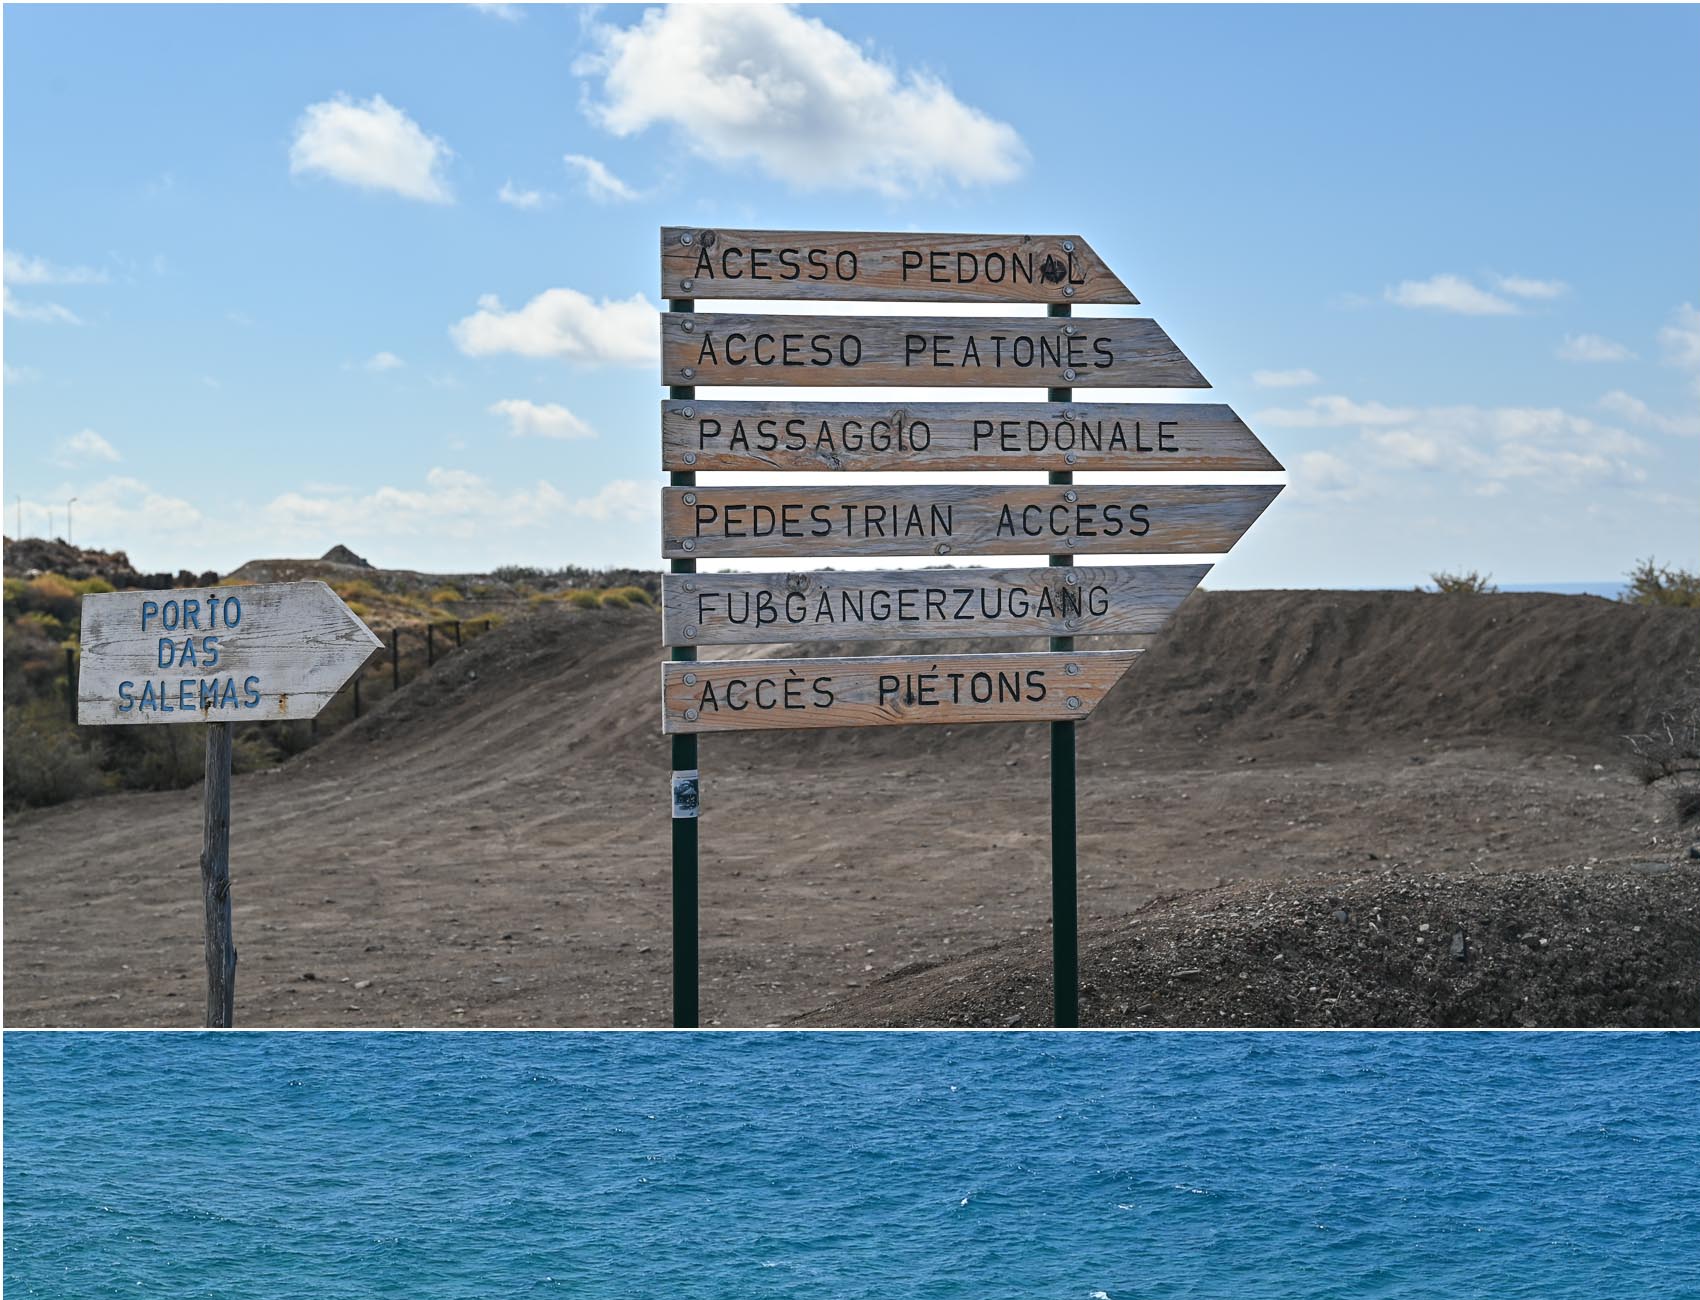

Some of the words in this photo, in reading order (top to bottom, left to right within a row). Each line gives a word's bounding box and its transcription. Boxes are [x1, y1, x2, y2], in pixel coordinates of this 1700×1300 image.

[694, 247, 858, 281] ACESSO
[903, 251, 1086, 285] PEDONAL
[697, 333, 862, 366] ACCESO
[905, 334, 1113, 369] PEATONES
[700, 420, 931, 452] PASSAGGIO
[973, 420, 1179, 452] PEDONALE
[695, 504, 953, 538] PEDESTRIAN
[997, 504, 1151, 537] ACCESS
[141, 597, 241, 631] PORTO
[158, 636, 219, 668] DAS
[118, 676, 260, 712] SALEMAS
[699, 669, 834, 712] ACCÈS
[879, 665, 1047, 707] PIÉTONS
